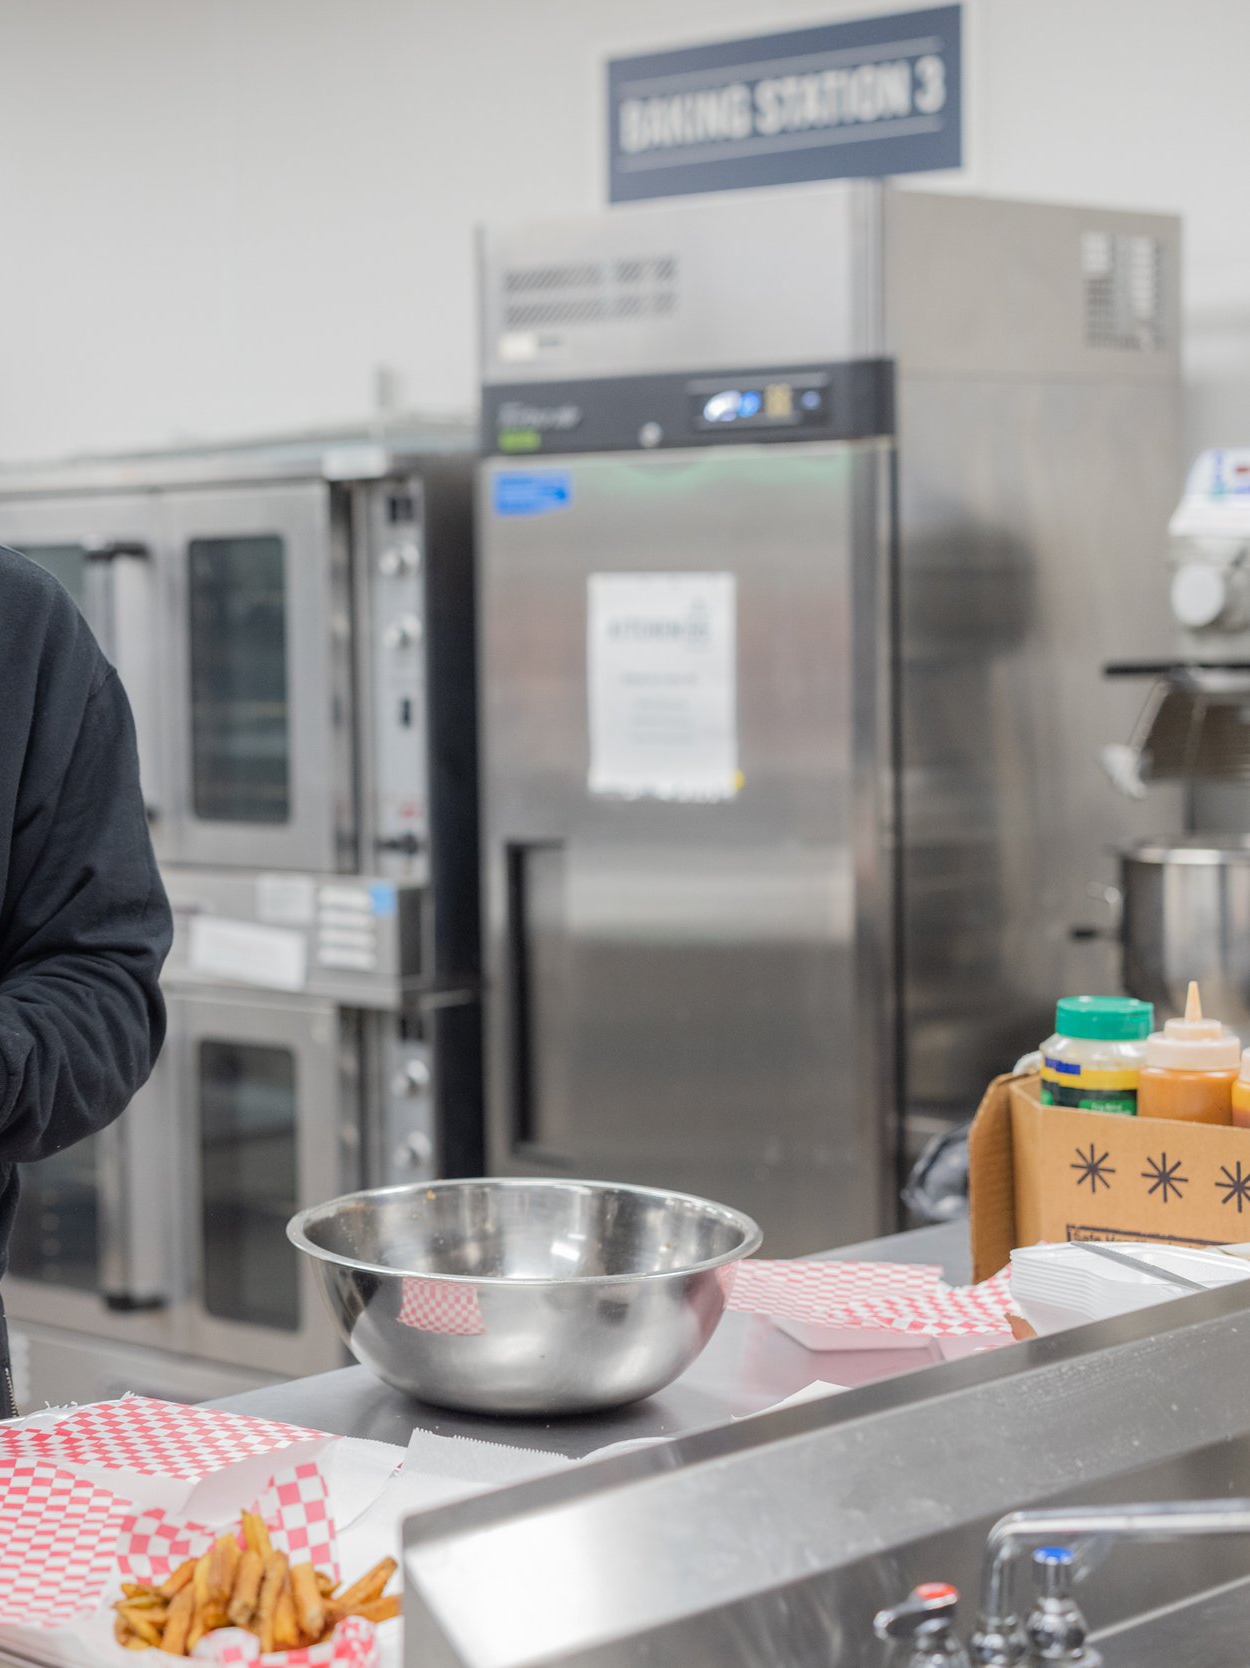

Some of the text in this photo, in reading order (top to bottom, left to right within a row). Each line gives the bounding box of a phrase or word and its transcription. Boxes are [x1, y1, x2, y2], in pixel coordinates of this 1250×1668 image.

[619, 54, 945, 153] BAKING STATION 3
